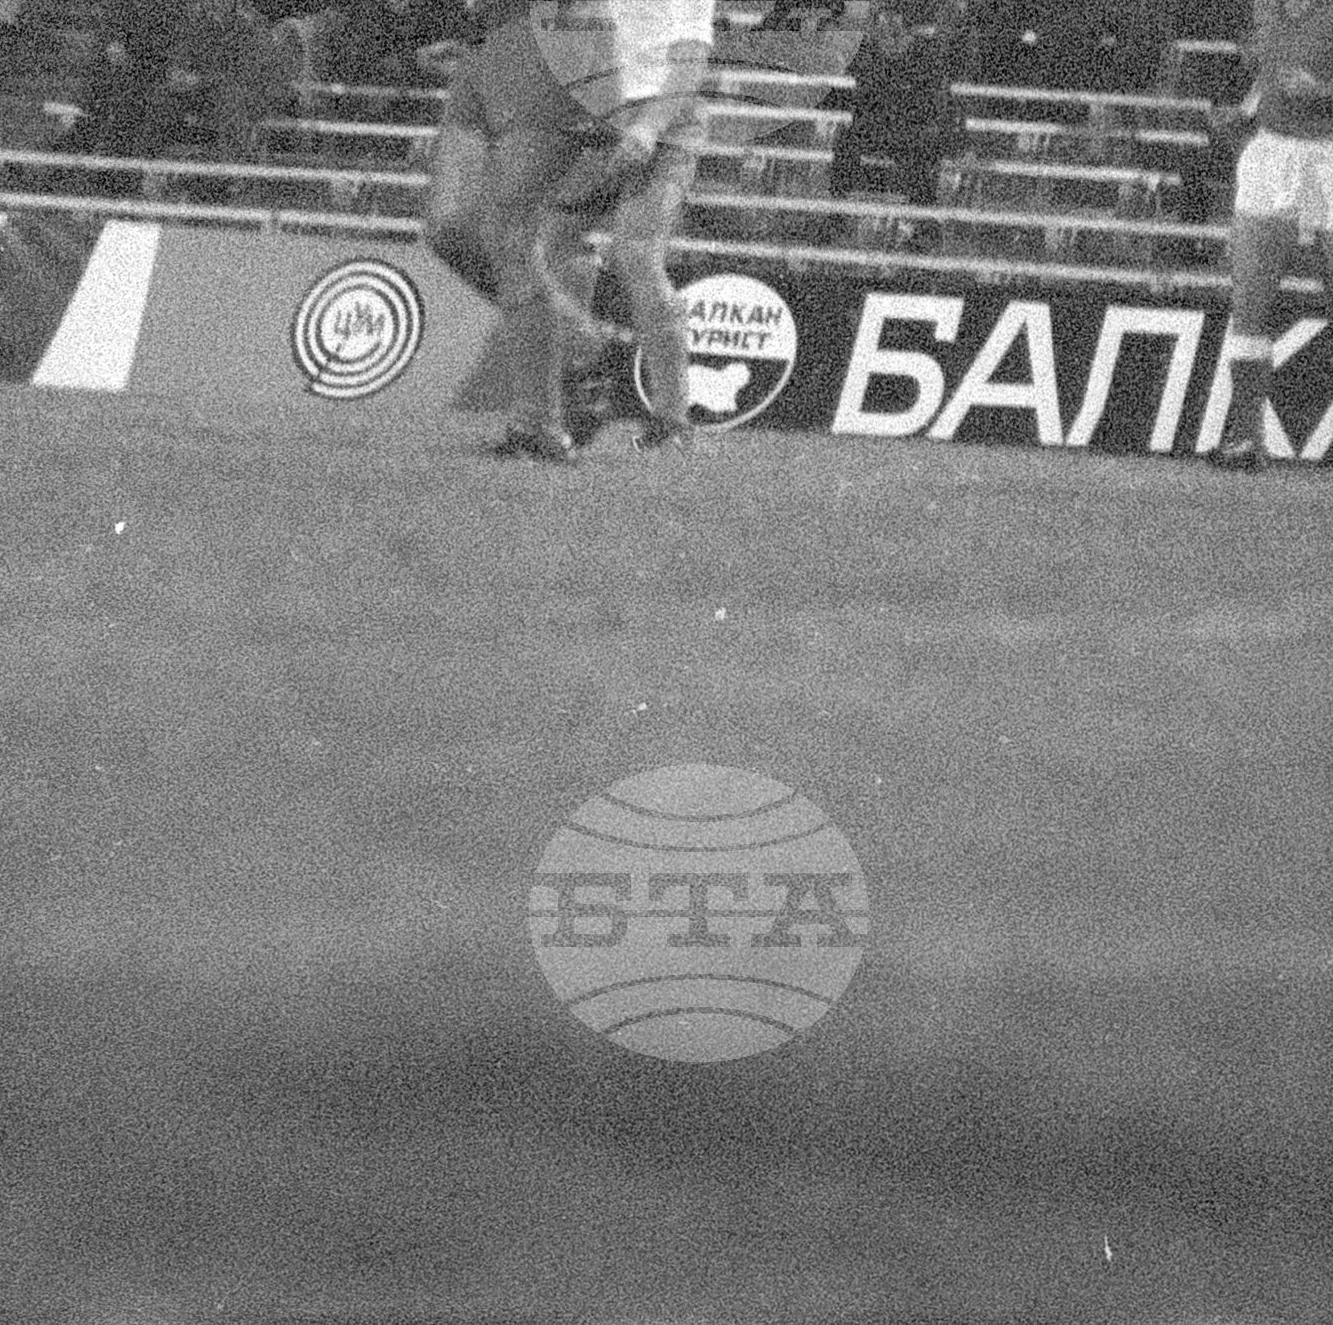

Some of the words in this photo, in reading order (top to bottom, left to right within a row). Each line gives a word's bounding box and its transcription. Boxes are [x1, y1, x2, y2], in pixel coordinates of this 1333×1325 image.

[683, 297, 785, 327] АЛКАН
[681, 325, 773, 352] УРИСТ
[829, 290, 1333, 462] БАЛК
